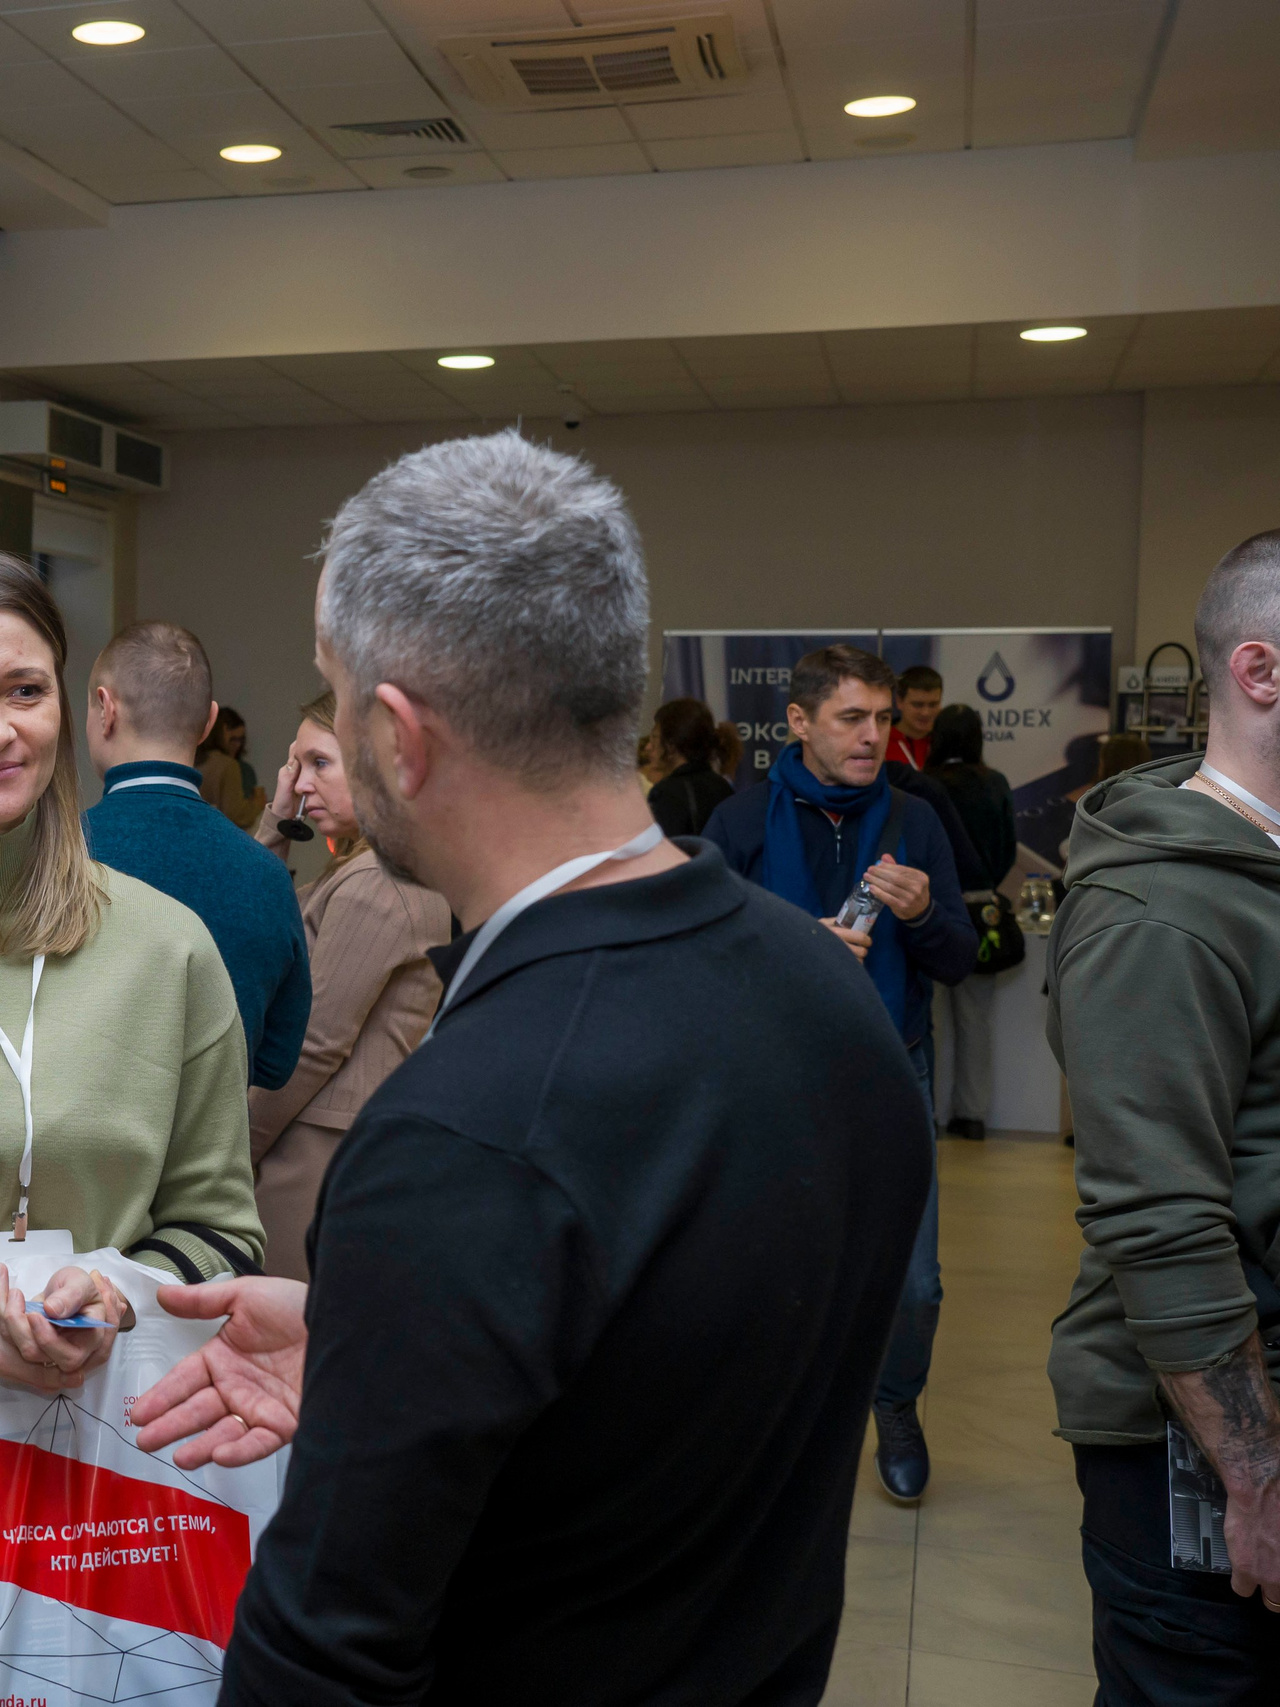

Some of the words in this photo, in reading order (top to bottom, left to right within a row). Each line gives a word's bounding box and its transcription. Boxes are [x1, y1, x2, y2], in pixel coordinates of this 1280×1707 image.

[153, 1517, 165, 1532] С
[168, 1514, 216, 1534] ТЕМИ,
[50, 1555, 77, 1571] КТО
